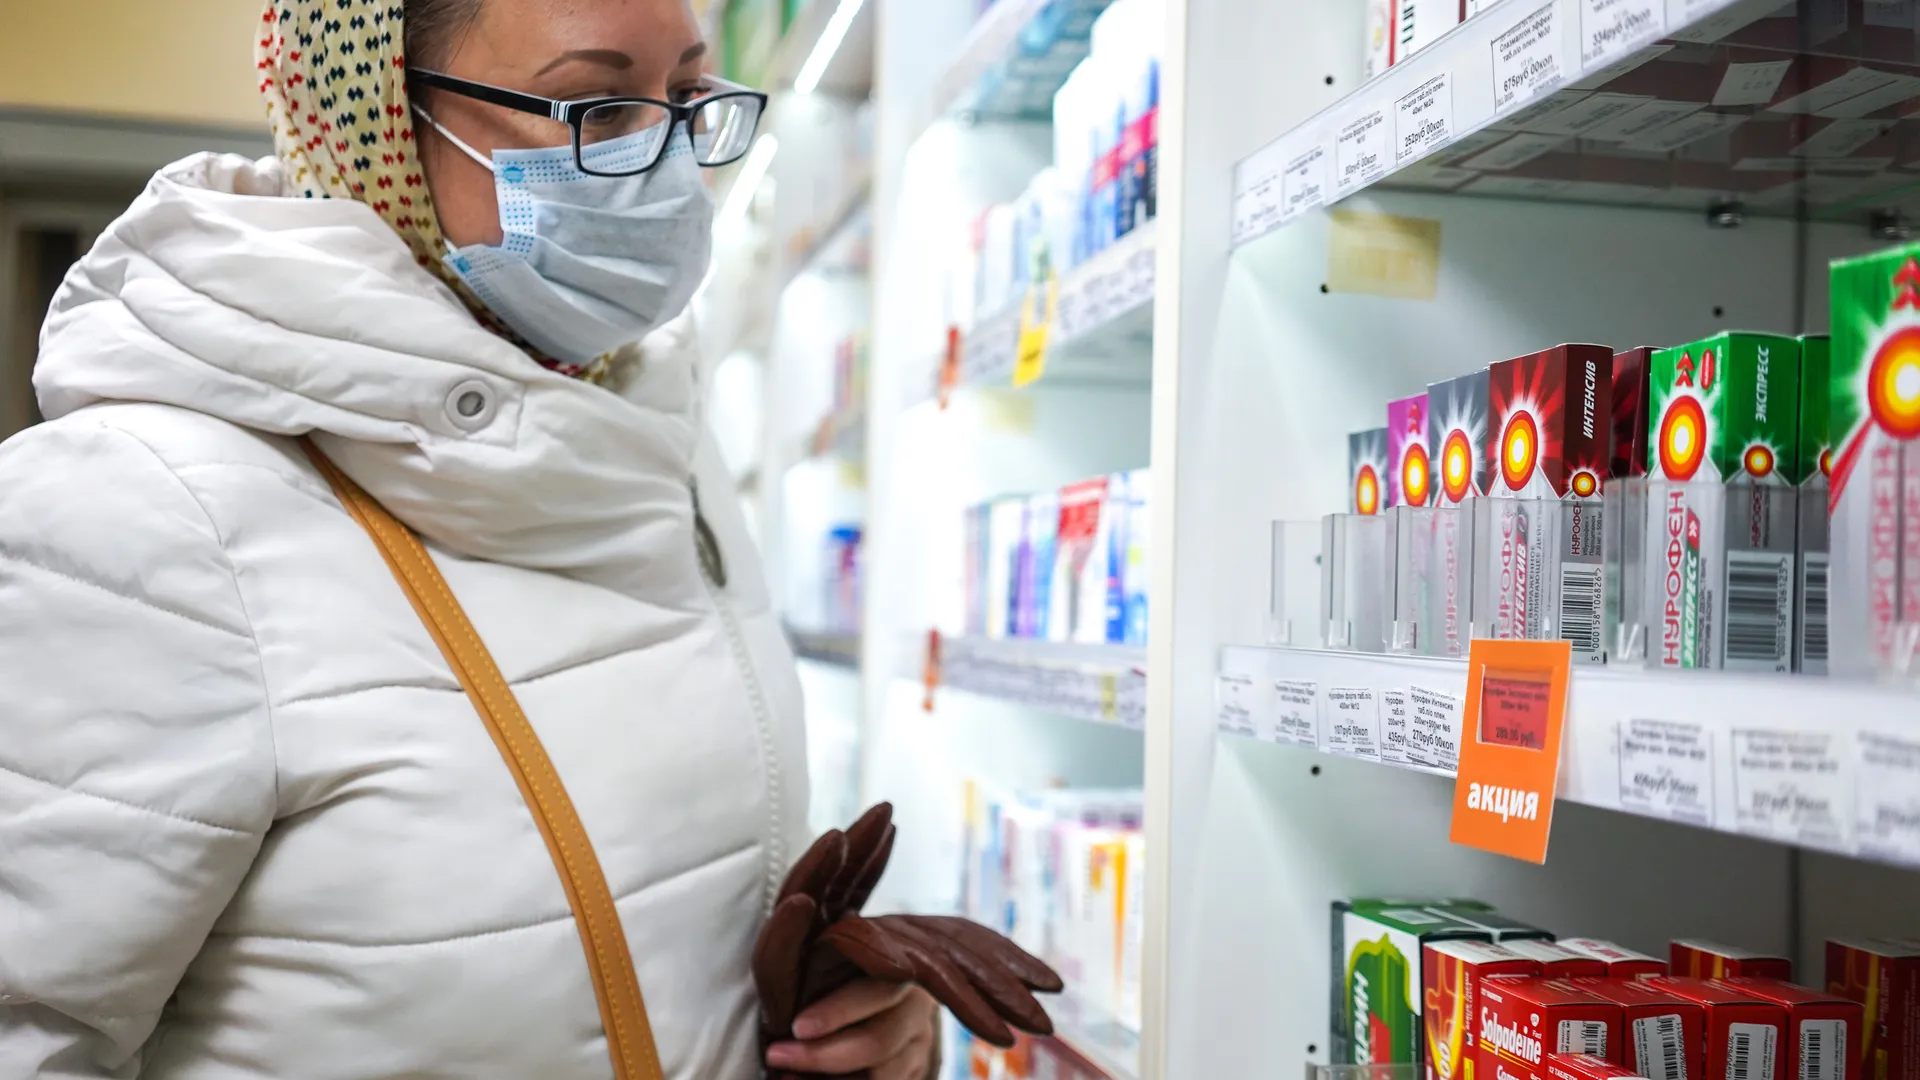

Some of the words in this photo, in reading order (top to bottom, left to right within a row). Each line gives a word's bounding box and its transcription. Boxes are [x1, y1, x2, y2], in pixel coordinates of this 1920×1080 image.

[1504, 67, 1528, 91] 675руб
[1530, 54, 1552, 75] 00коп
[1404, 127, 1425, 147] 252руб
[1426, 119, 1444, 135] 00коп
[1583, 360, 1596, 439] ИНТЕНСИВ
[1755, 344, 1769, 423] ЭКСПРЕСС
[1594, 576, 1602, 609] 106826
[1664, 491, 1685, 666] НУРОФЕН
[1684, 550, 1697, 667] ЭКСПРЕСС
[1411, 693, 1431, 705] Нурофен
[1431, 698, 1454, 711] Интенсив
[1334, 725, 1352, 737] 107руб
[1352, 726, 1368, 736] 00коп
[1413, 729, 1434, 746] 270руб
[1434, 736, 1454, 750] 00коп
[1467, 782, 1540, 823] акция
[1481, 1006, 1541, 1064] Solpadeine
[1532, 1030, 1542, 1039] Fast
[1548, 1066, 1554, 1074] 12
